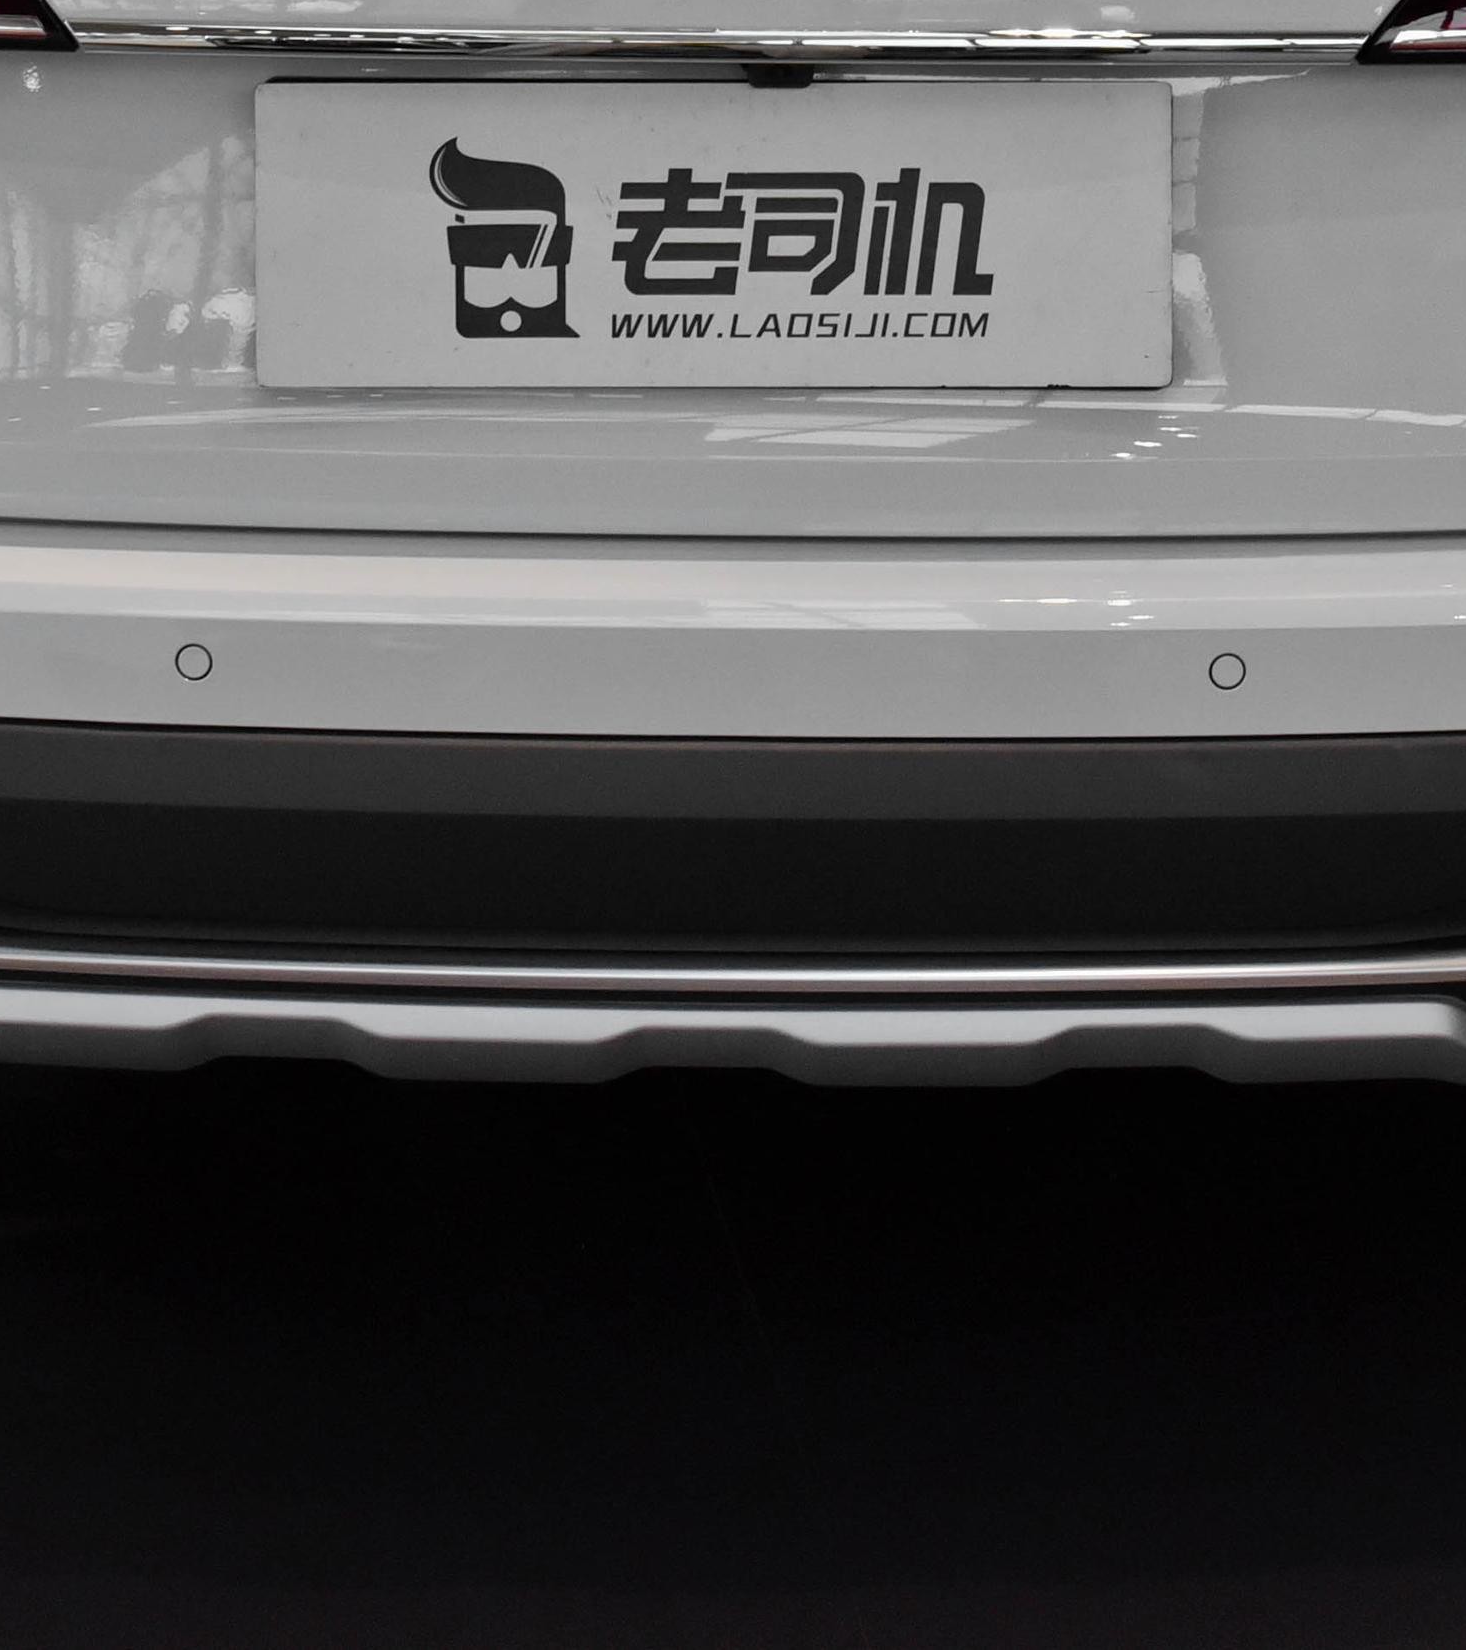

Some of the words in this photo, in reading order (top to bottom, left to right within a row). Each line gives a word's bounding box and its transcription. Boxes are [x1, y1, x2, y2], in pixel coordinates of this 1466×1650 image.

[611, 167, 994, 296] 老司机
[610, 312, 990, 339] WWW.LAOSIJI.COM
